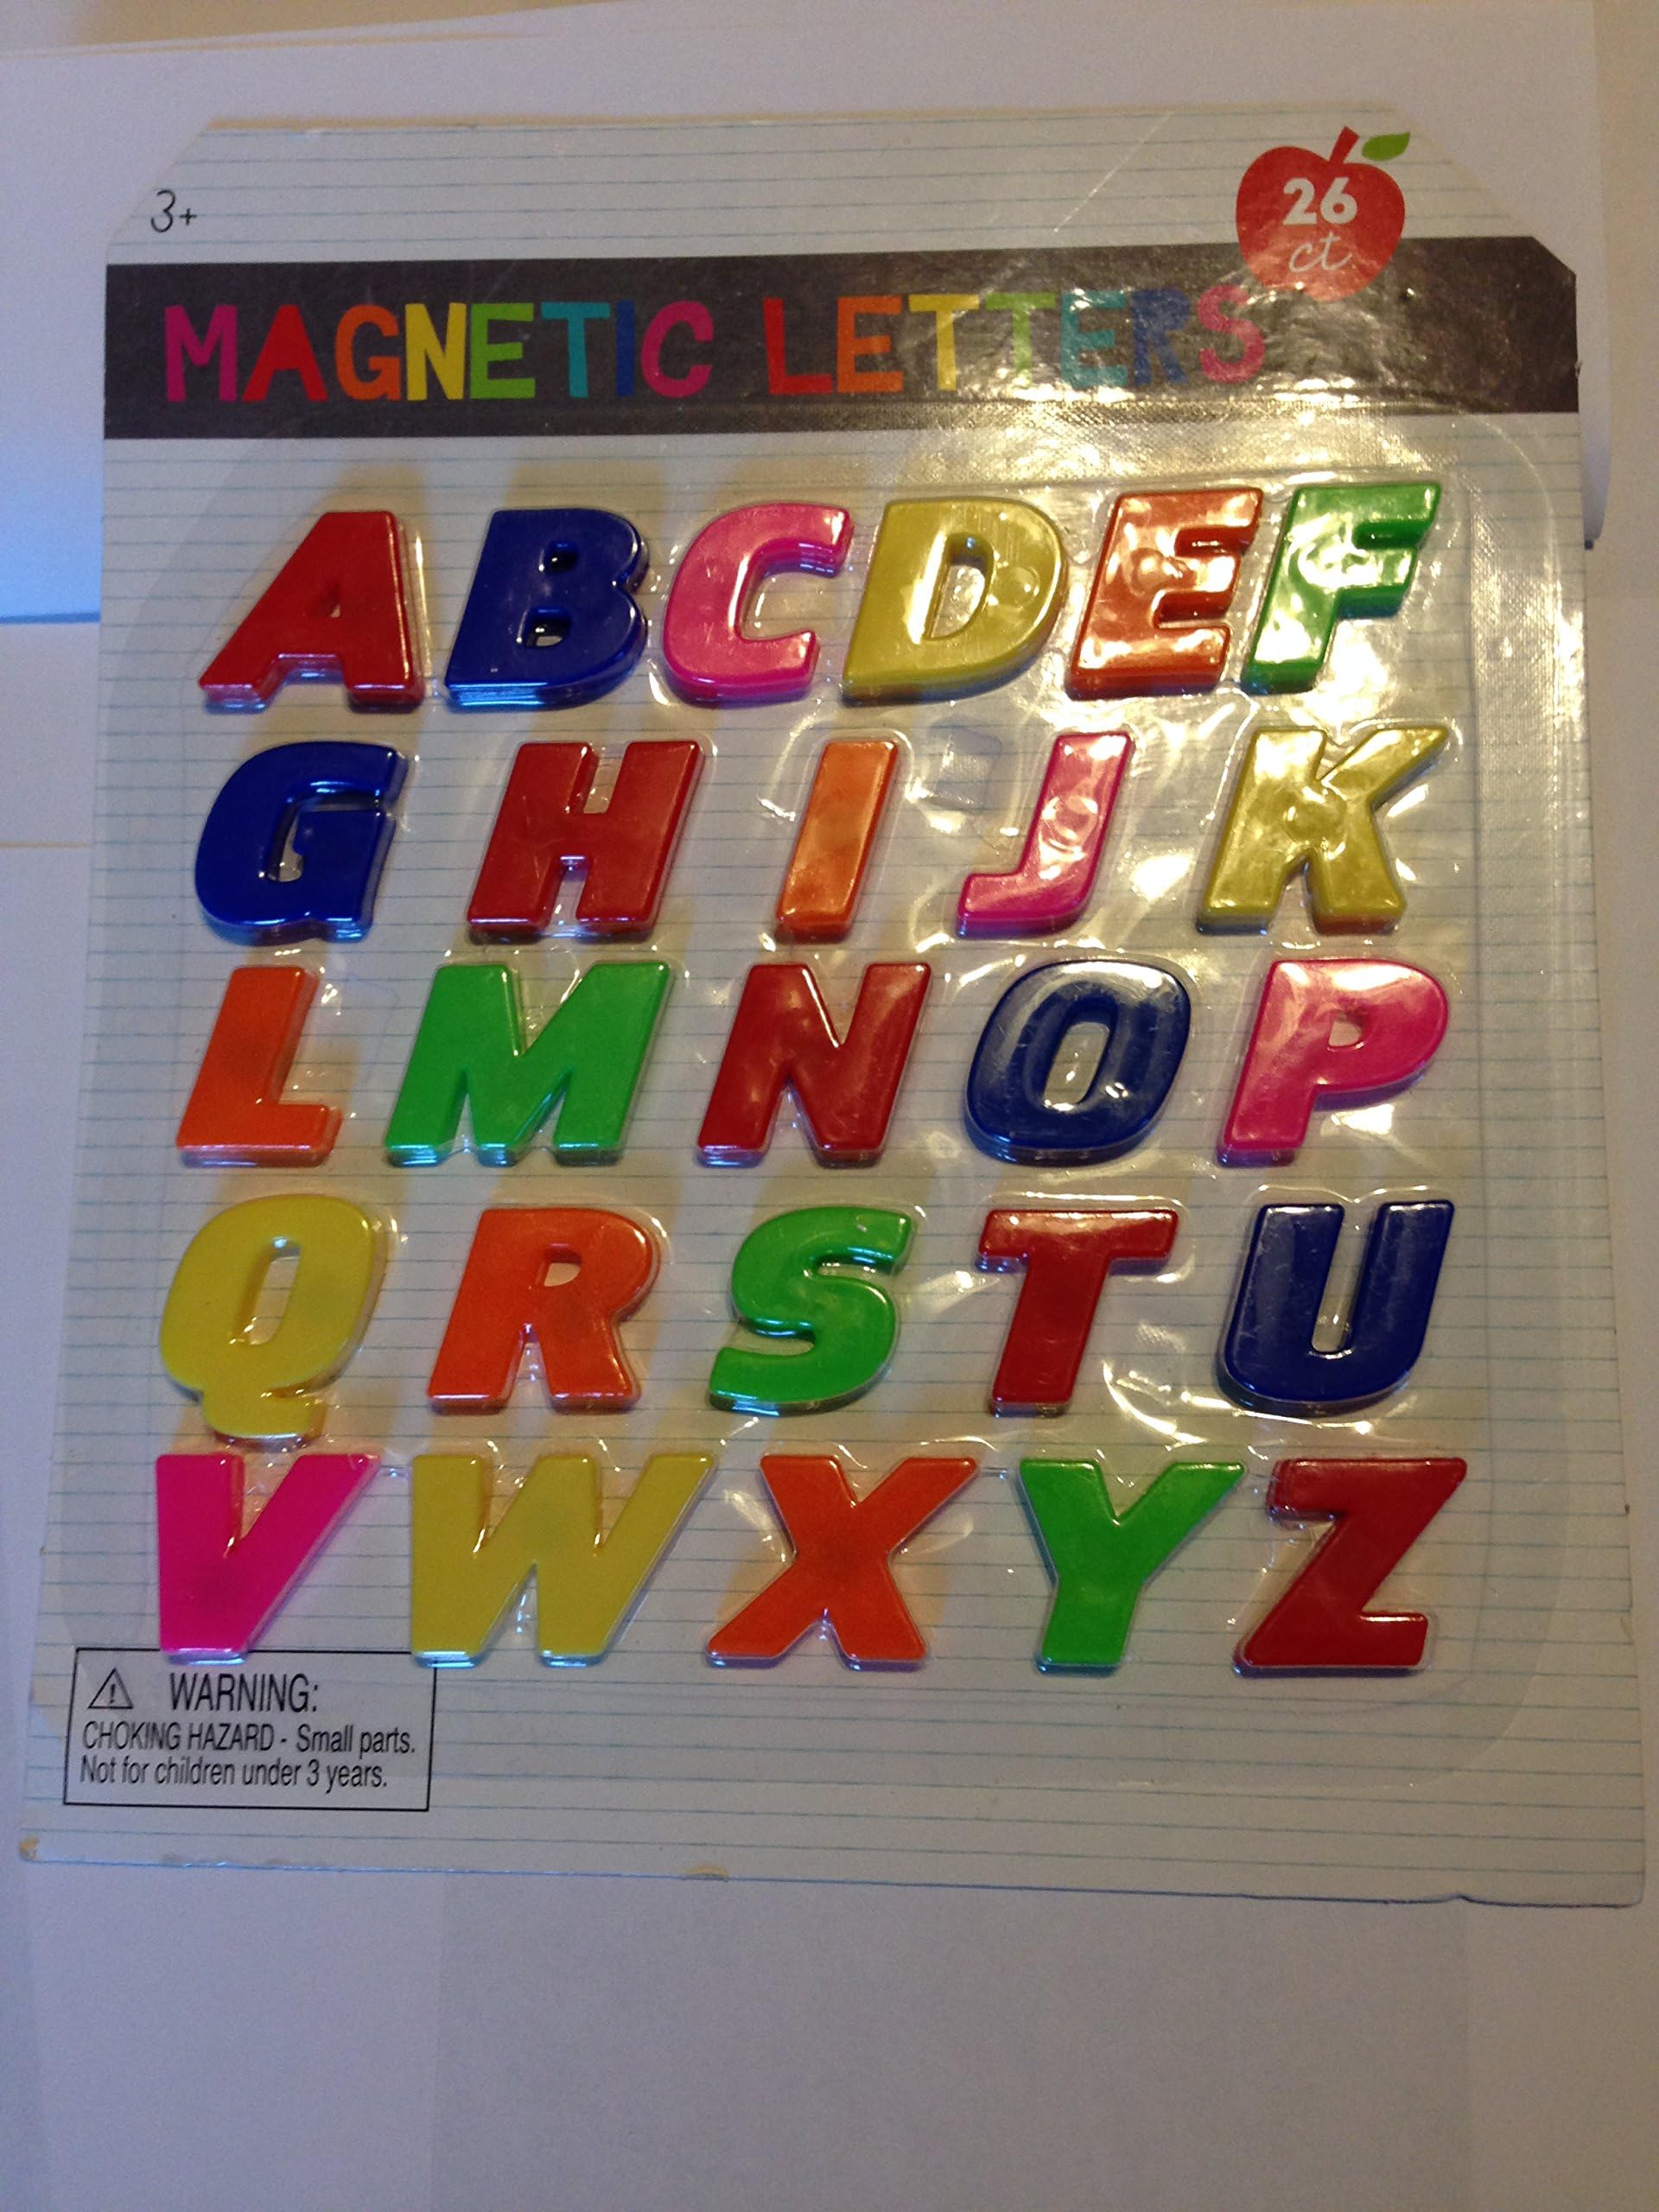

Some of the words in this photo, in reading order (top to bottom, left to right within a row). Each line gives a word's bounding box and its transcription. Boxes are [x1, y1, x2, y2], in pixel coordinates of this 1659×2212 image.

[150, 189, 197, 233] 3+
[1282, 175, 1357, 226] 26
[163, 299, 715, 403] MAGNETIC
[762, 283, 1265, 396] LETTERS
[199, 511, 425, 714] A
[444, 507, 650, 711] B
[663, 502, 854, 705] C
[842, 495, 1068, 703] D
[1067, 487, 1264, 700] E
[1243, 481, 1442, 695] F
[195, 741, 408, 944] G
[467, 741, 705, 943] H
[776, 739, 900, 944] I
[957, 730, 1136, 938] J
[1198, 726, 1450, 935] K
[176, 965, 342, 1166] L
[385, 961, 674, 1167] M
[697, 963, 932, 1167] N
[965, 959, 1192, 1166] O
[1218, 958, 1450, 1167] P
[159, 1194, 389, 1445] Q
[427, 1207, 660, 1415] R
[709, 1206, 915, 1416] S
[976, 1210, 1179, 1417] T
[1218, 1199, 1456, 1417] U
[156, 1453, 382, 1665] V
[411, 1453, 717, 1669] W
[705, 1456, 979, 1672] X
[1018, 1458, 1246, 1675] Y
[1233, 1457, 1468, 1678] Z
[82, 1720, 181, 1751] CHOKING
[188, 1722, 275, 1752] HAZARD
[296, 1722, 353, 1754] Small
[358, 1726, 416, 1760] parts.
[169, 1672, 319, 1713] WARNING:
[79, 1754, 117, 1783] Not
[122, 1755, 150, 1785] for
[155, 1755, 236, 1786] children
[242, 1757, 302, 1788] under
[306, 1758, 321, 1788] 3
[325, 1764, 388, 1796] years.
